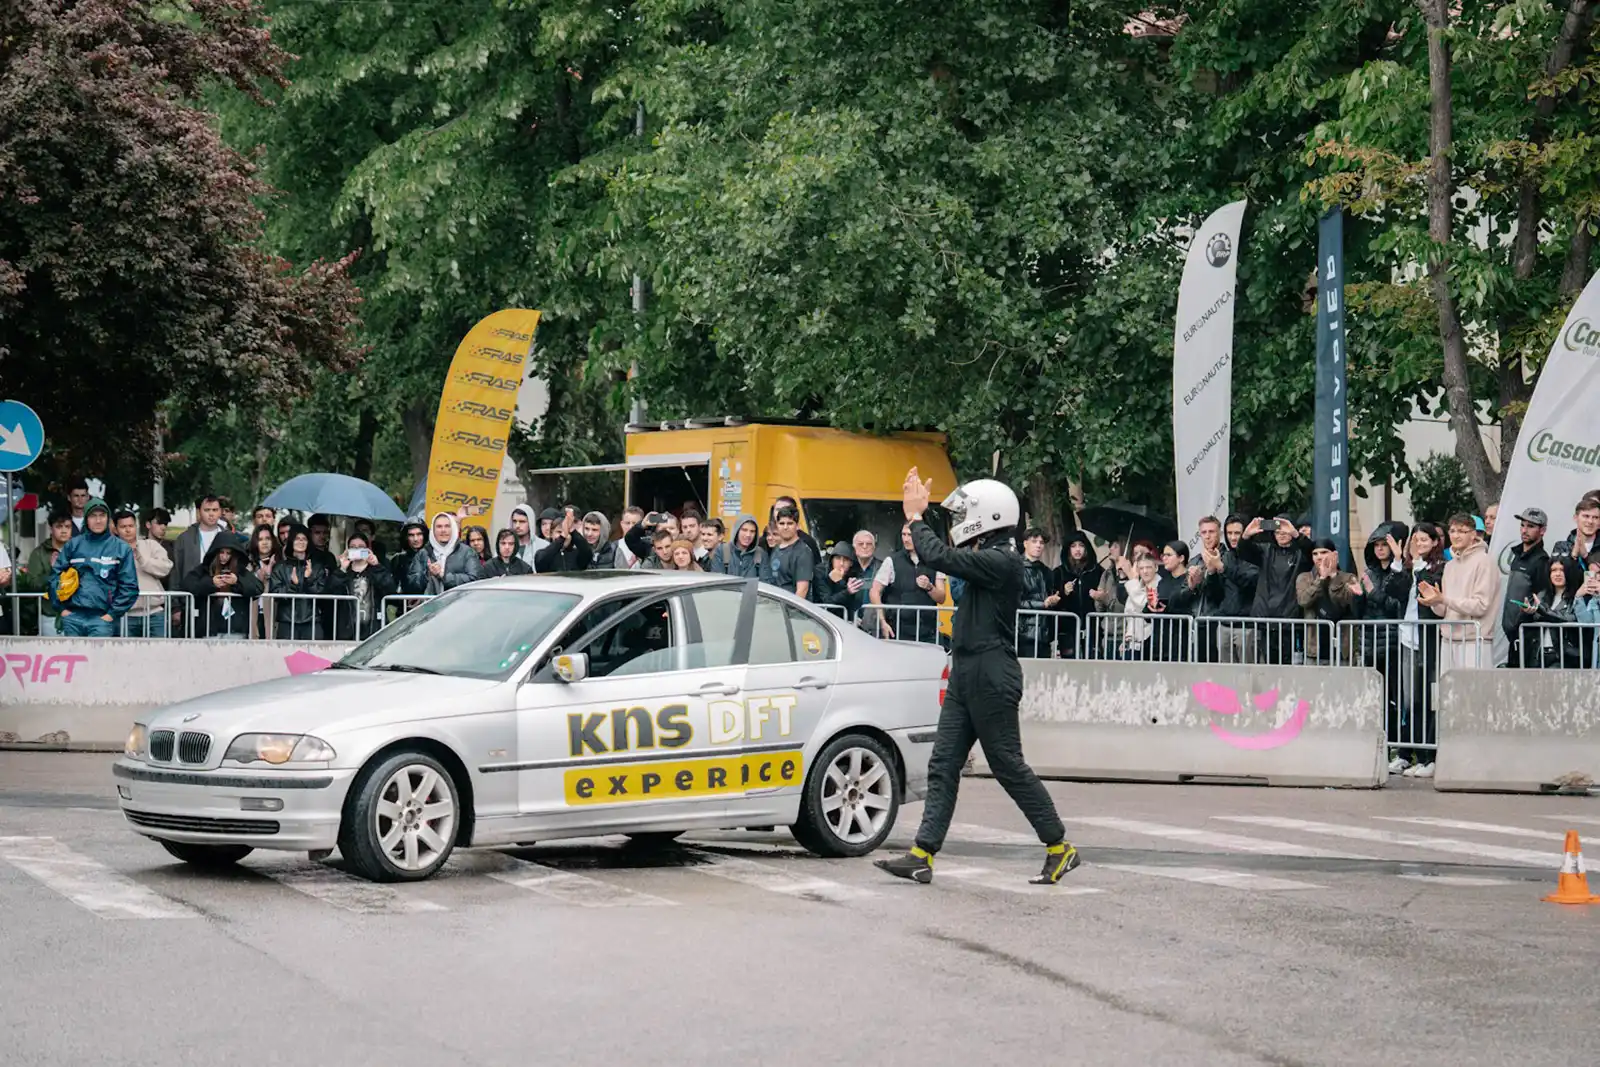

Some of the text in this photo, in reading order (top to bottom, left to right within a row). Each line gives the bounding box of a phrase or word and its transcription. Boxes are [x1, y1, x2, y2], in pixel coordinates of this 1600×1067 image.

[1183, 290, 1232, 342] EURONAUTICA
[496, 328, 530, 341] FRAS
[1573, 322, 1600, 348] Ca
[480, 347, 524, 364] FRAS
[468, 371, 518, 391] FRAS
[1183, 353, 1230, 405] EURONAUTICA
[460, 401, 513, 421] FRAS
[454, 430, 506, 450] FRAS
[447, 460, 500, 480] FRAS
[442, 491, 494, 510] FRAS
[0, 653, 89, 692] RIFT
[707, 694, 797, 745] DFT
